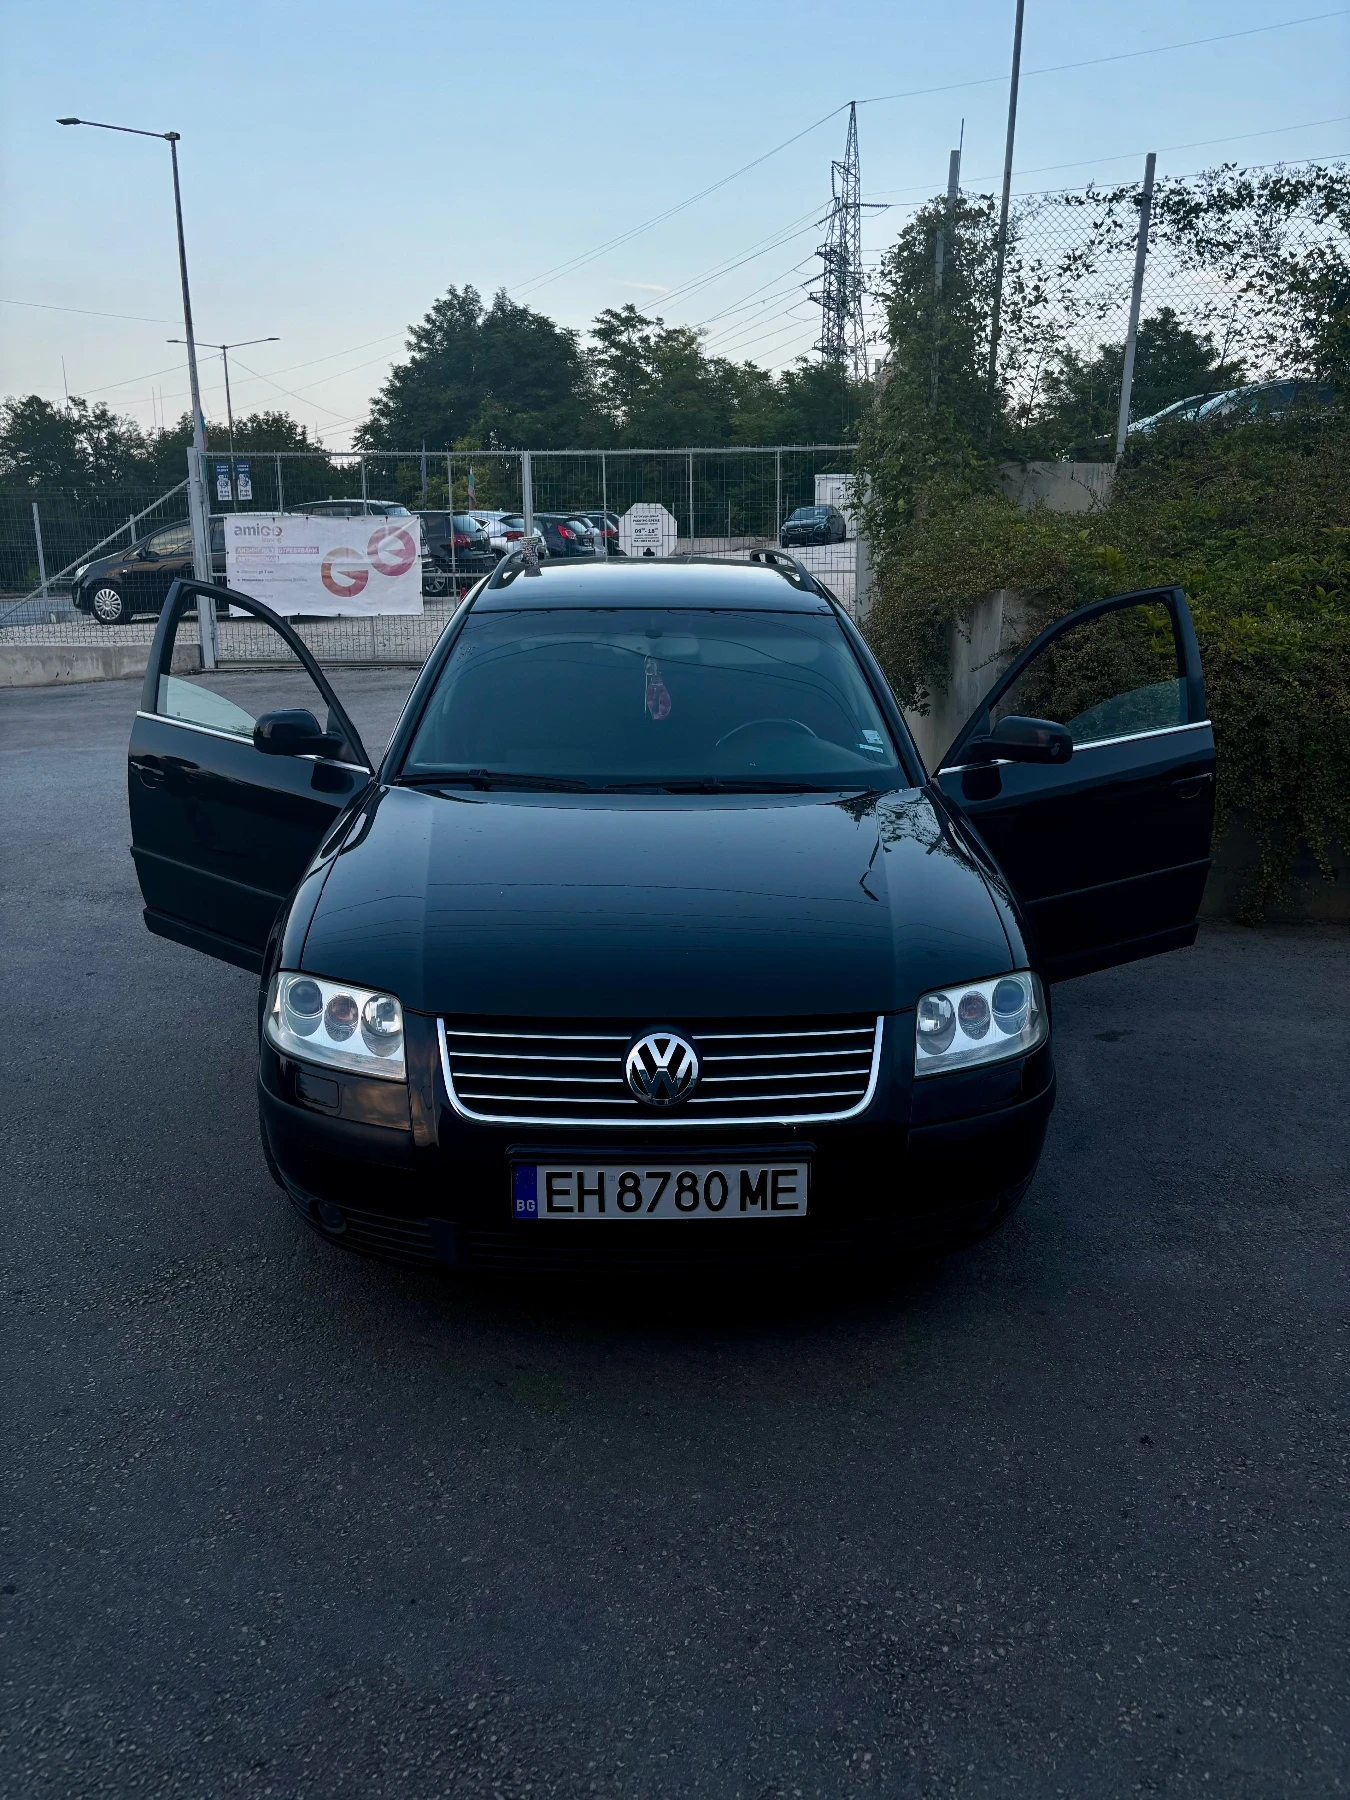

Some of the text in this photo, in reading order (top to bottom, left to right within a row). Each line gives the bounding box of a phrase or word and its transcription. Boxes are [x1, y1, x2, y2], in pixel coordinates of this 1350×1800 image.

[545, 1168, 799, 1213] EH 8780 ME
[516, 1199, 536, 1212] BG
